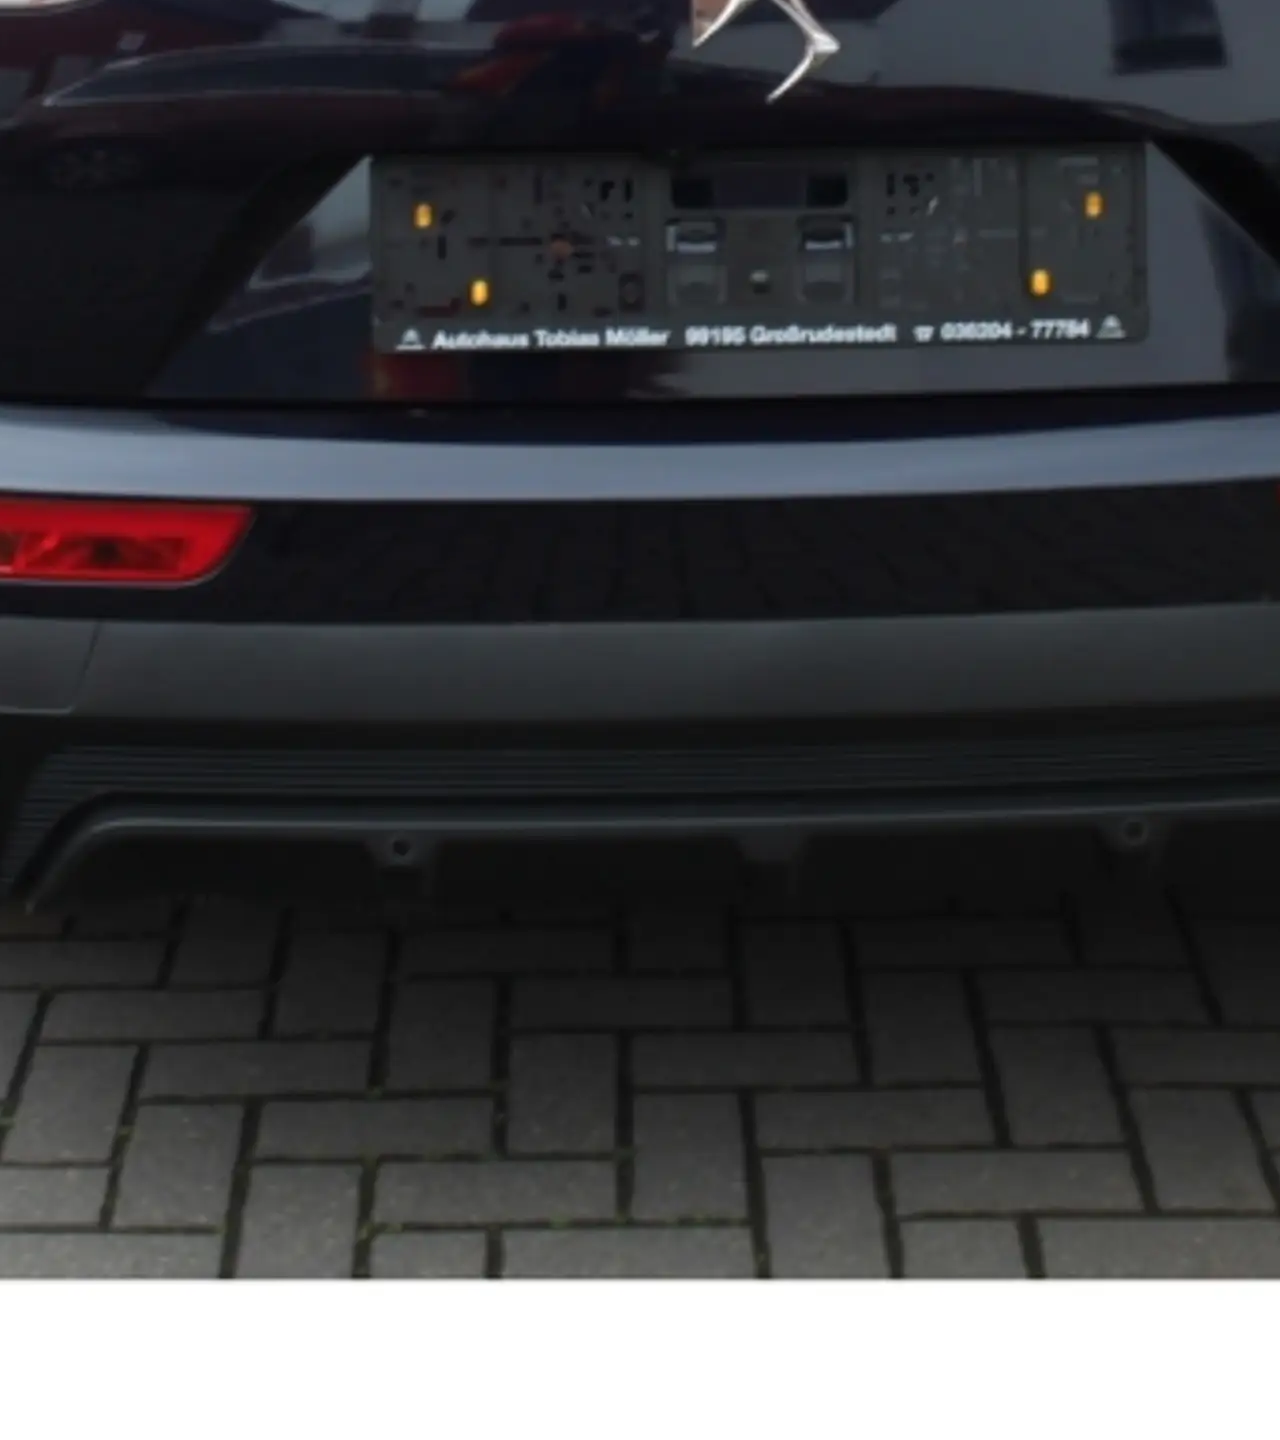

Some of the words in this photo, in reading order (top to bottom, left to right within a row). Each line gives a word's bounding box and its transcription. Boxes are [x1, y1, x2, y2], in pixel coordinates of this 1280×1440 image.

[431, 328, 530, 350] Autohaus
[533, 328, 600, 348] Tobias
[604, 324, 671, 347] Möller
